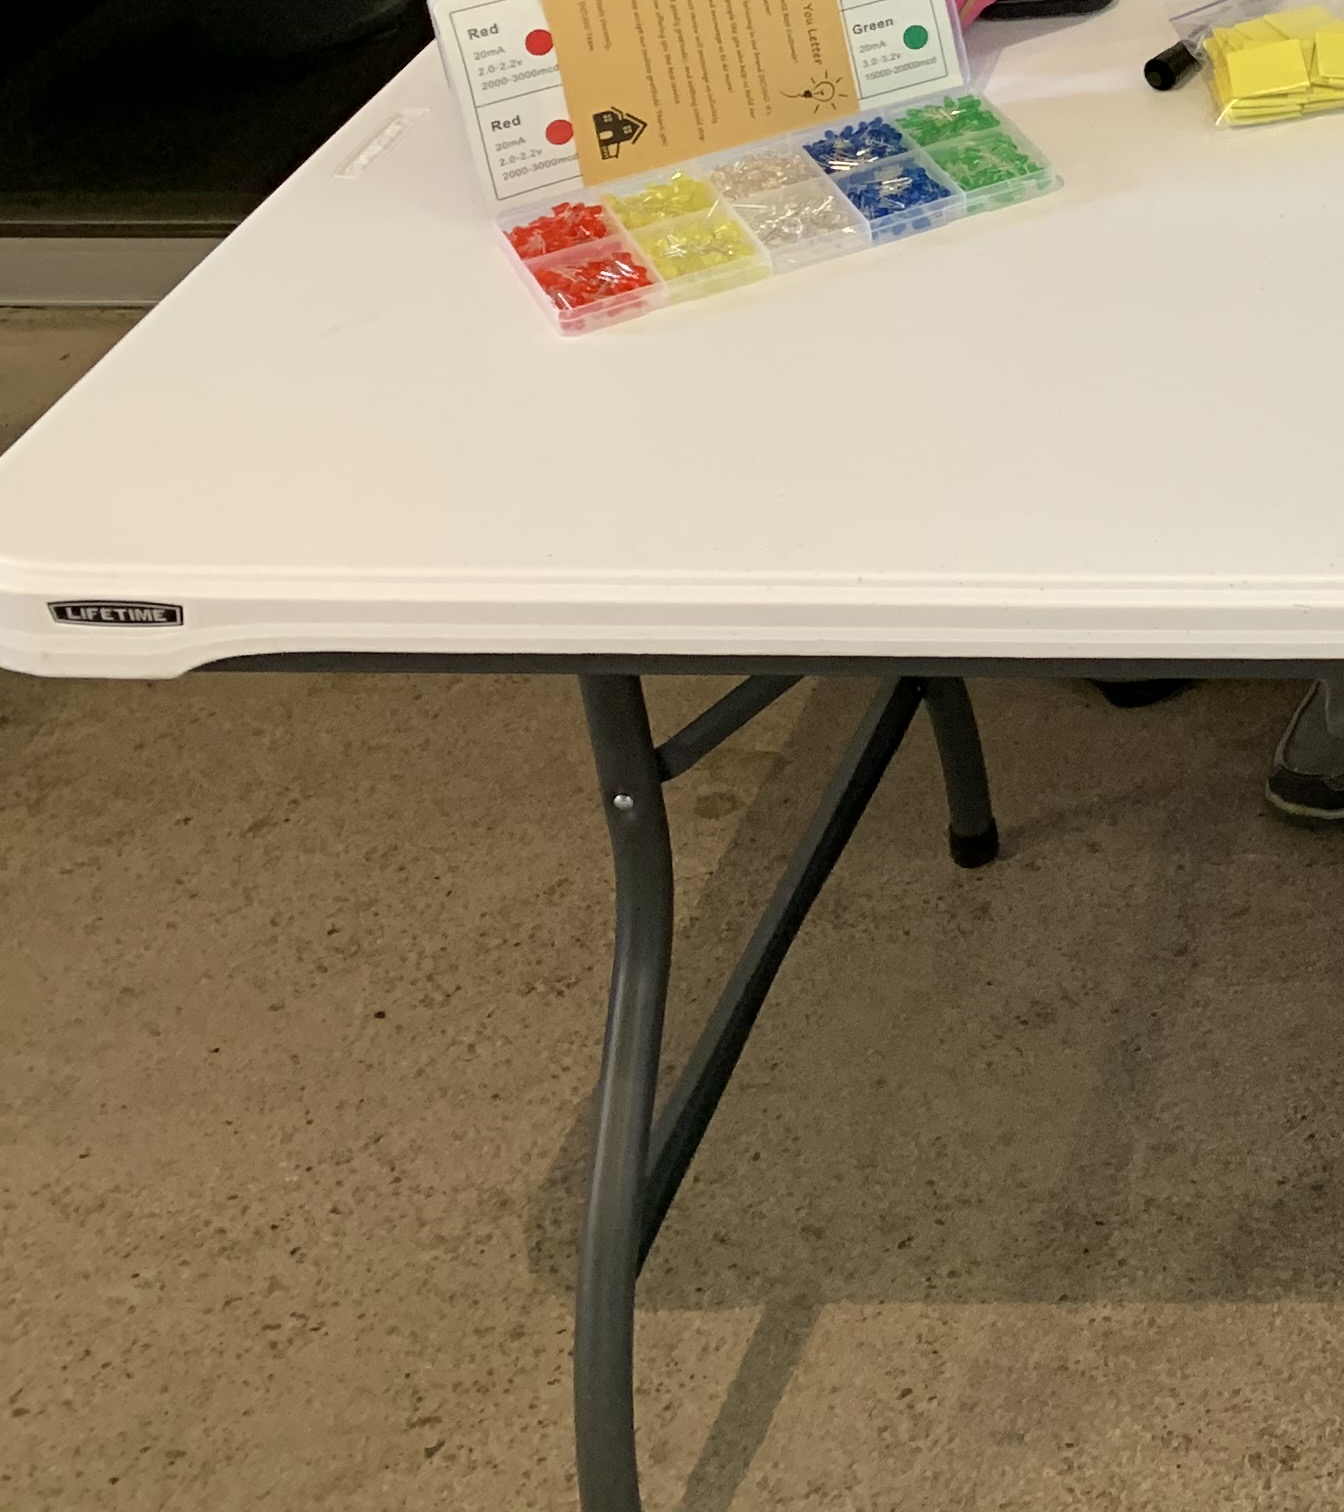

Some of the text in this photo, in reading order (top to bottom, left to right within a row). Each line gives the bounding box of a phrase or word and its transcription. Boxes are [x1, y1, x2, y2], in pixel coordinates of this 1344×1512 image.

[802, 3, 817, 25] You
[467, 23, 499, 40] Red
[852, 17, 894, 35] Green
[473, 46, 506, 60] 20mA
[807, 28, 827, 65] Letter
[478, 59, 523, 76] 2.0-2.2v
[491, 115, 521, 132] Red
[495, 137, 526, 152] 20mA
[499, 148, 543, 167] 2.0-2.2v
[65, 606, 167, 623] LIFETIME
